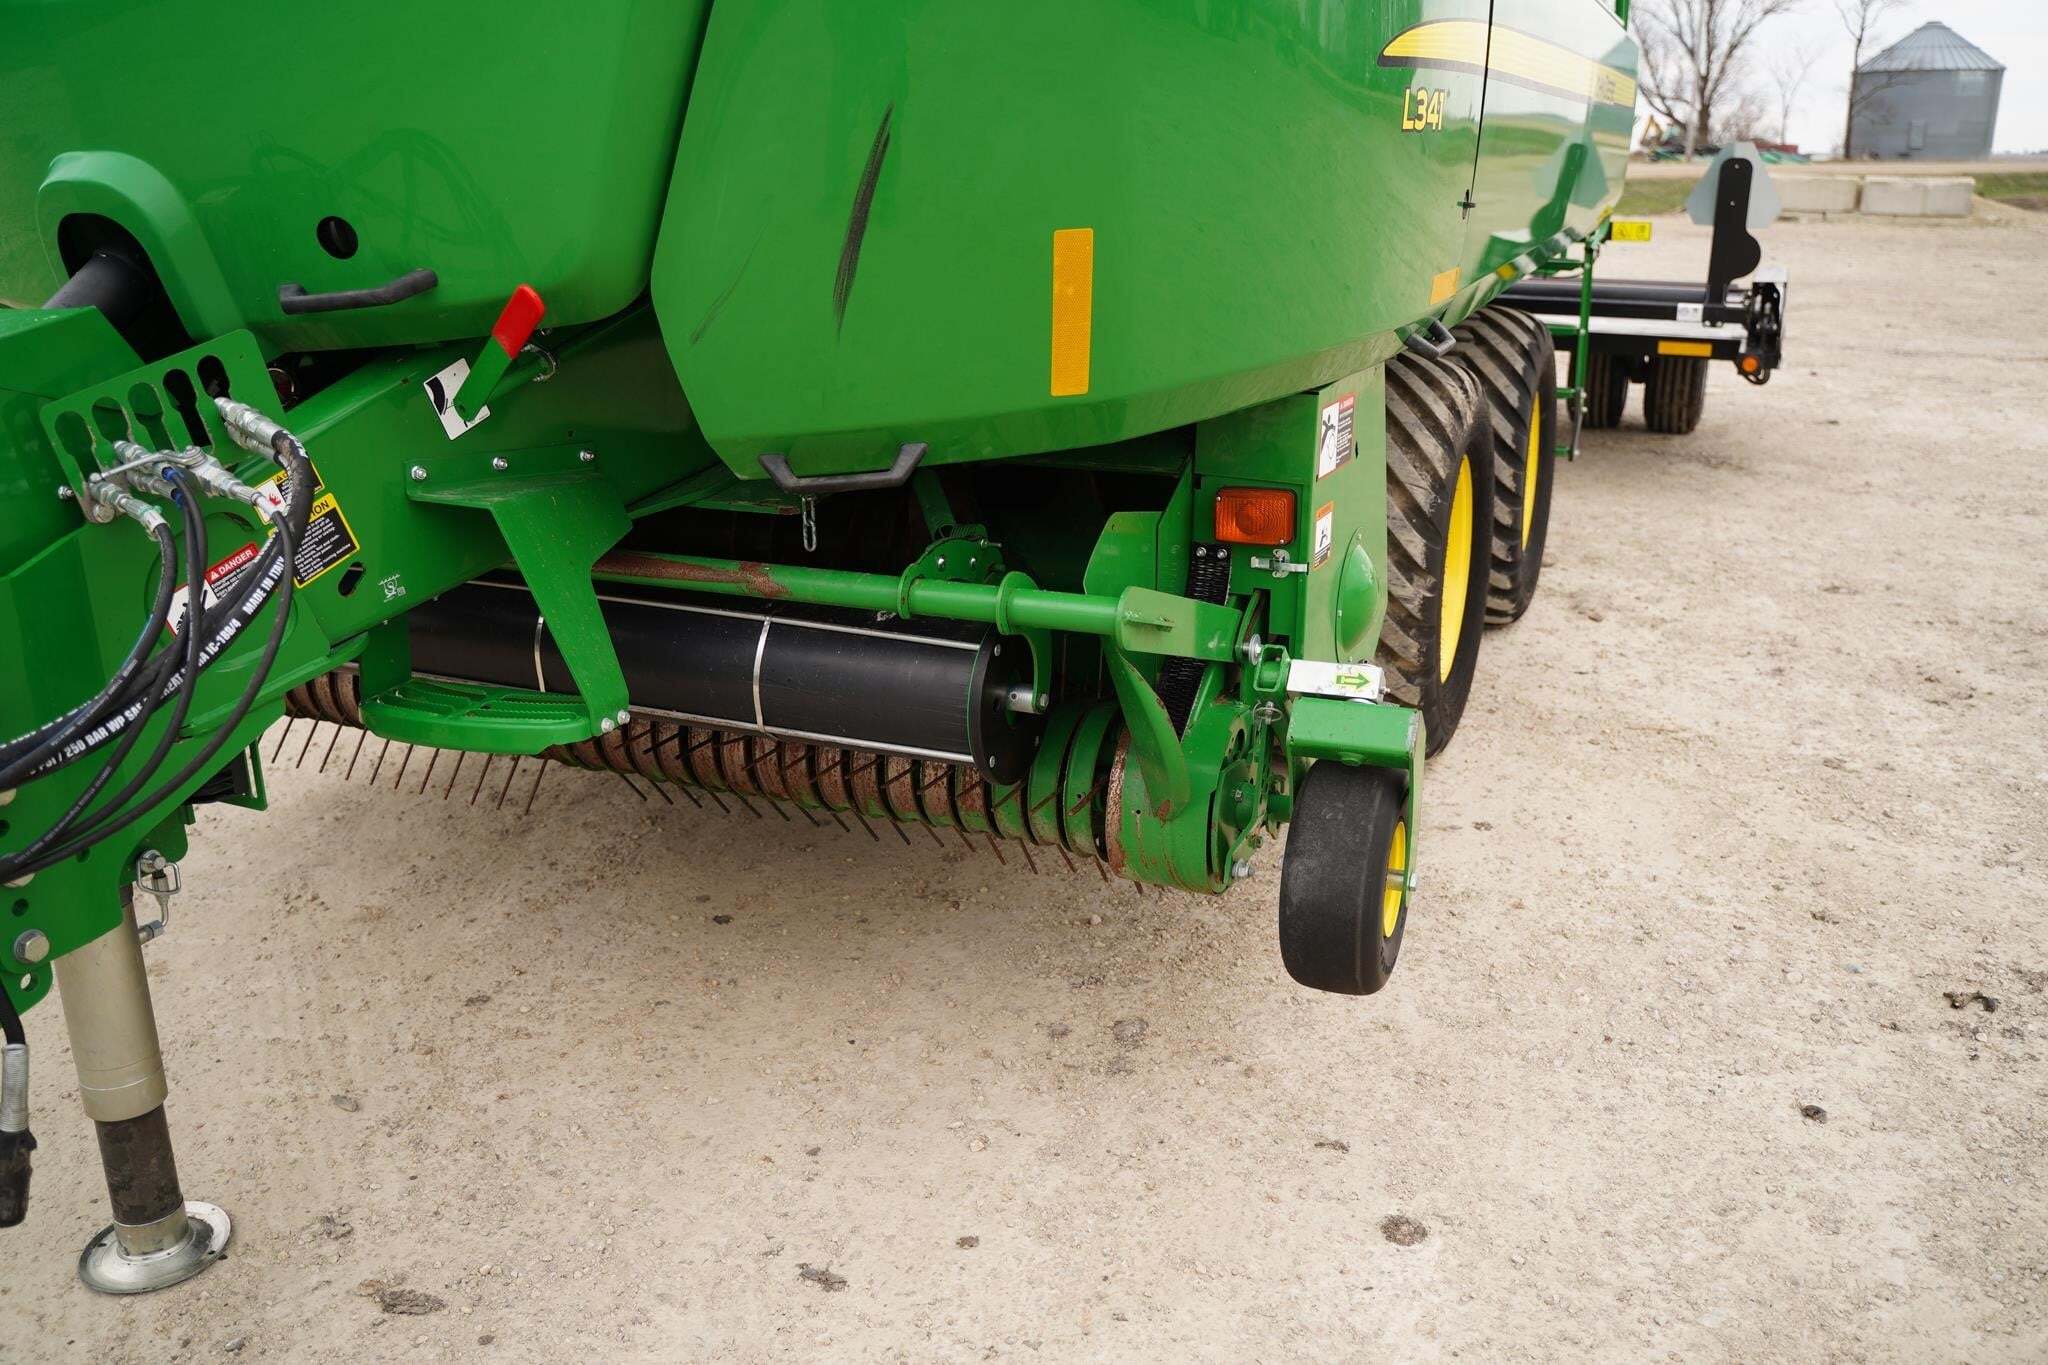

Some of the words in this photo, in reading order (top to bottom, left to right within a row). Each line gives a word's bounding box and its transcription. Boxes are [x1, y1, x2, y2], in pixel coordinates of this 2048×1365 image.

[1402, 87, 1446, 132] L341
[218, 549, 254, 574] DANGER
[242, 587, 267, 615] MADE
[261, 577, 275, 592] IN
[64, 740, 86, 758] 250
[85, 727, 109, 747] BAR
[105, 716, 126, 733] WP
